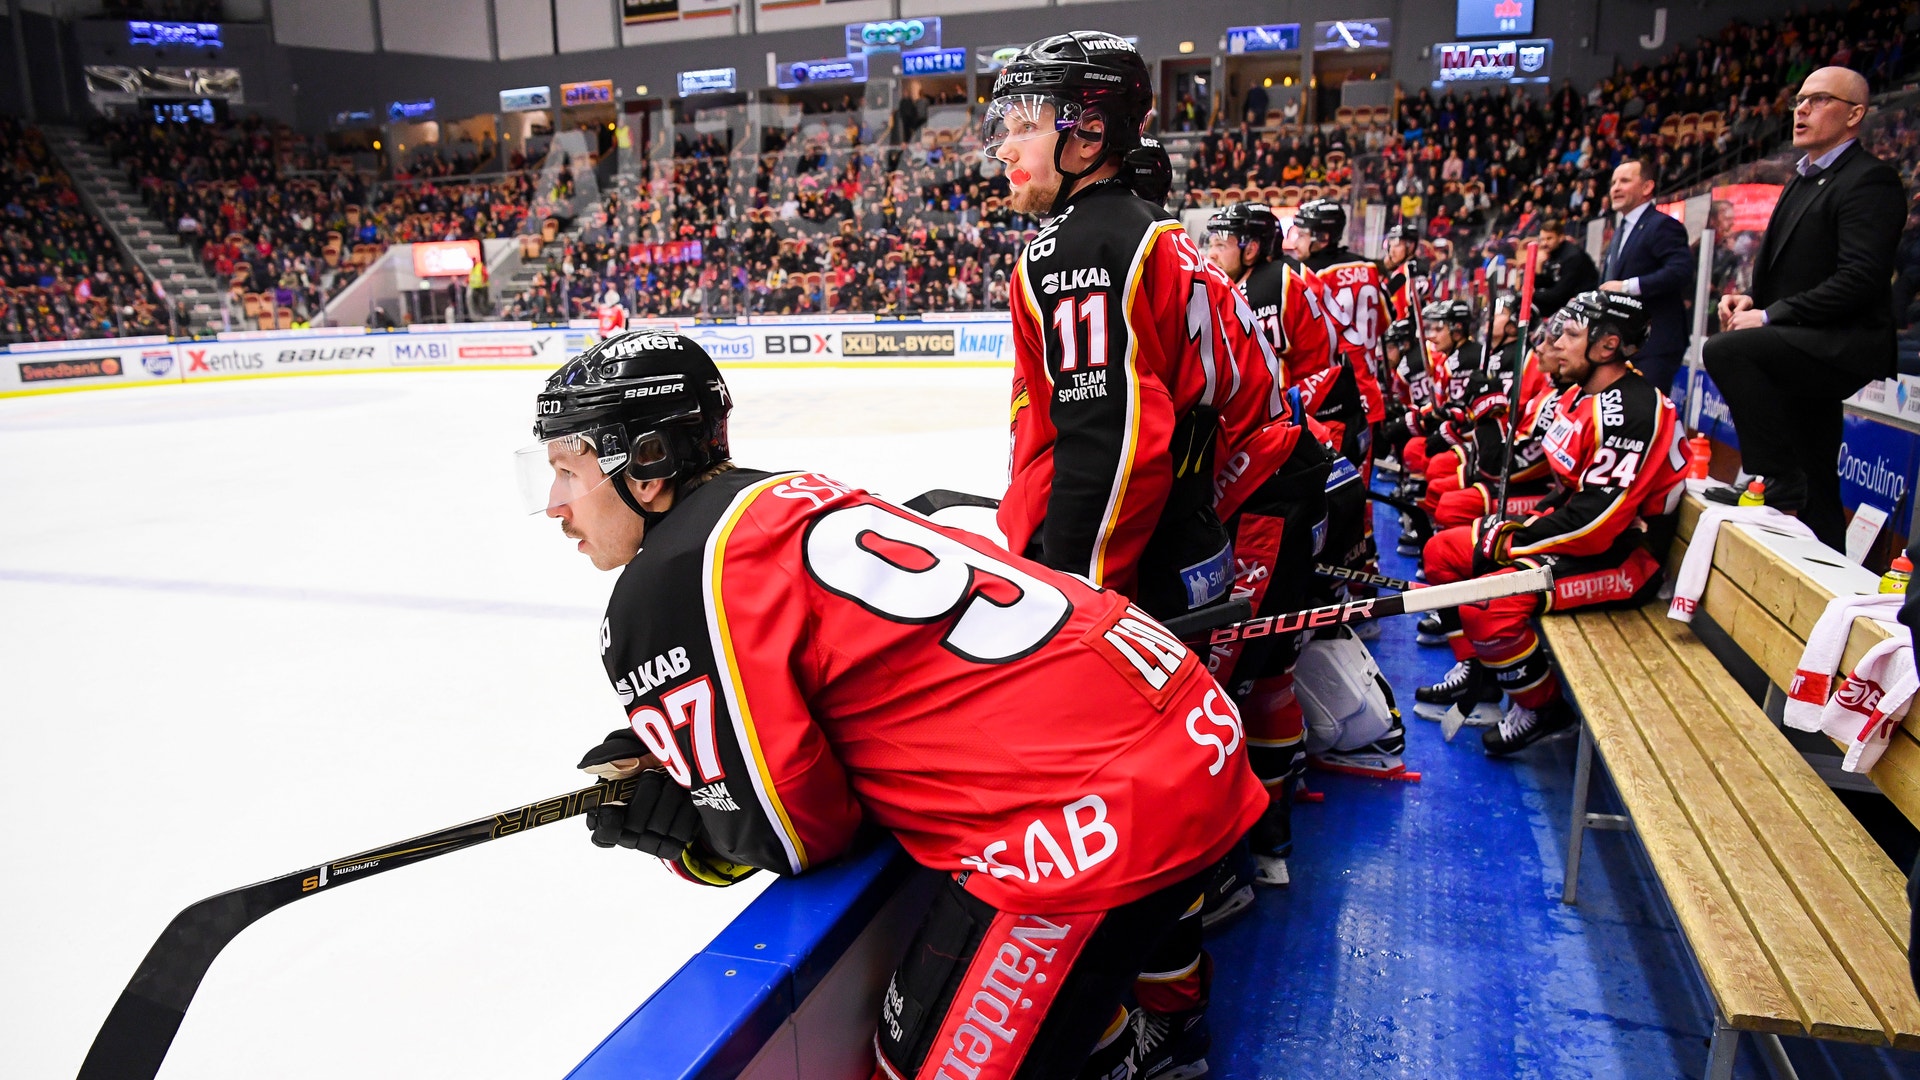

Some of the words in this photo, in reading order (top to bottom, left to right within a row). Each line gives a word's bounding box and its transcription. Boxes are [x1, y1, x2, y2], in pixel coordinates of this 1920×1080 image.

[1640, 8, 1667, 50] J
[1083, 71, 1123, 83] BAUER
[1139, 137, 1161, 149] ter.
[1060, 267, 1111, 293] LKAB
[877, 334, 954, 352] XL-BYGG
[1052, 291, 1109, 373] 11
[277, 346, 376, 364] BAUER
[395, 343, 447, 360] MABI
[600, 335, 684, 359] vinter.
[765, 334, 833, 354] BDX
[22, 361, 101, 381] Swedbank
[187, 349, 265, 372] Xentus
[1071, 370, 1107, 388] TEAM
[623, 383, 685, 400] BAUER
[1058, 383, 1108, 404] SPORTIA
[1585, 447, 1642, 489] 24
[1837, 442, 1905, 511] Consulting
[803, 502, 1074, 665] 9
[1314, 562, 1406, 590] BAUER
[1210, 597, 1375, 645] BAUER
[628, 646, 691, 698] LKAB
[628, 673, 727, 789] 97
[333, 860, 381, 876] SUPREME
